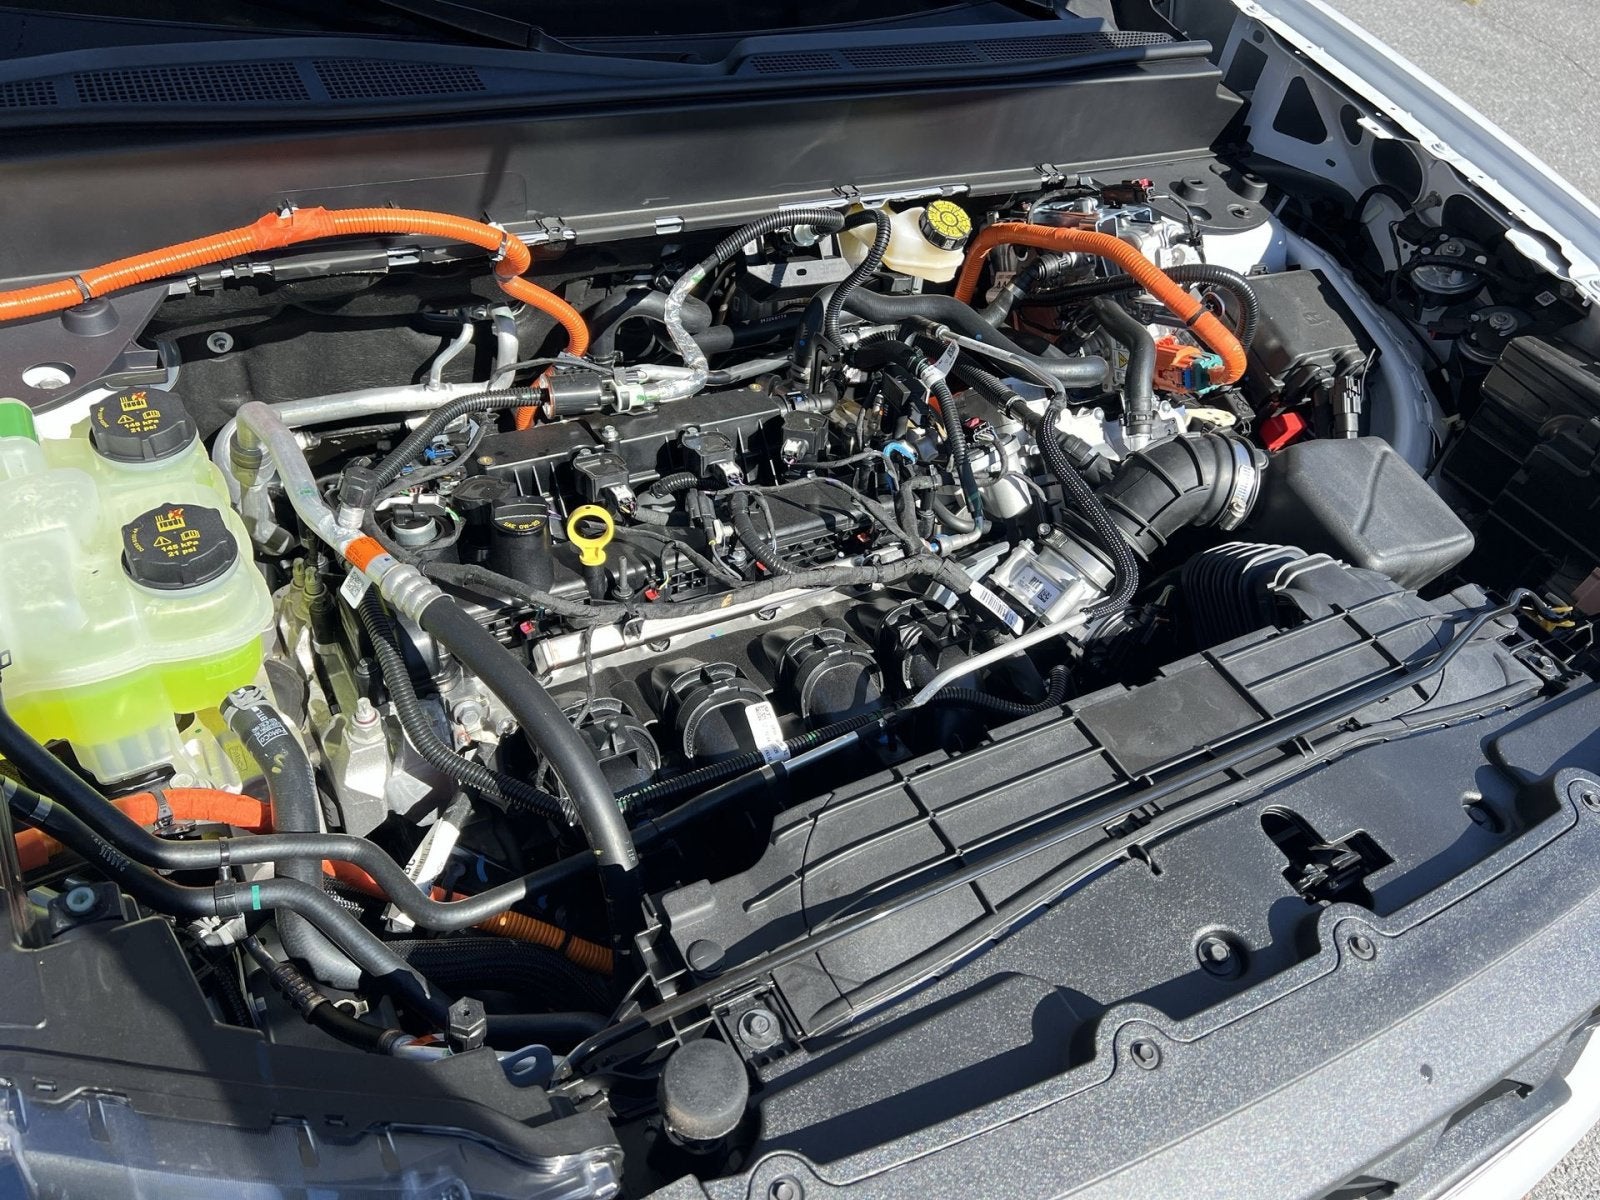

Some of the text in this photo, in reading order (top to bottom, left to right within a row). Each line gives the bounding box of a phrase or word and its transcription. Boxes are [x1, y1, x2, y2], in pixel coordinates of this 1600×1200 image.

[124, 421, 141, 429] 145
[143, 424, 157, 432] psi
[503, 521, 517, 529] SAE
[161, 540, 199, 552] 145 kPa
[182, 547, 197, 555] psi
